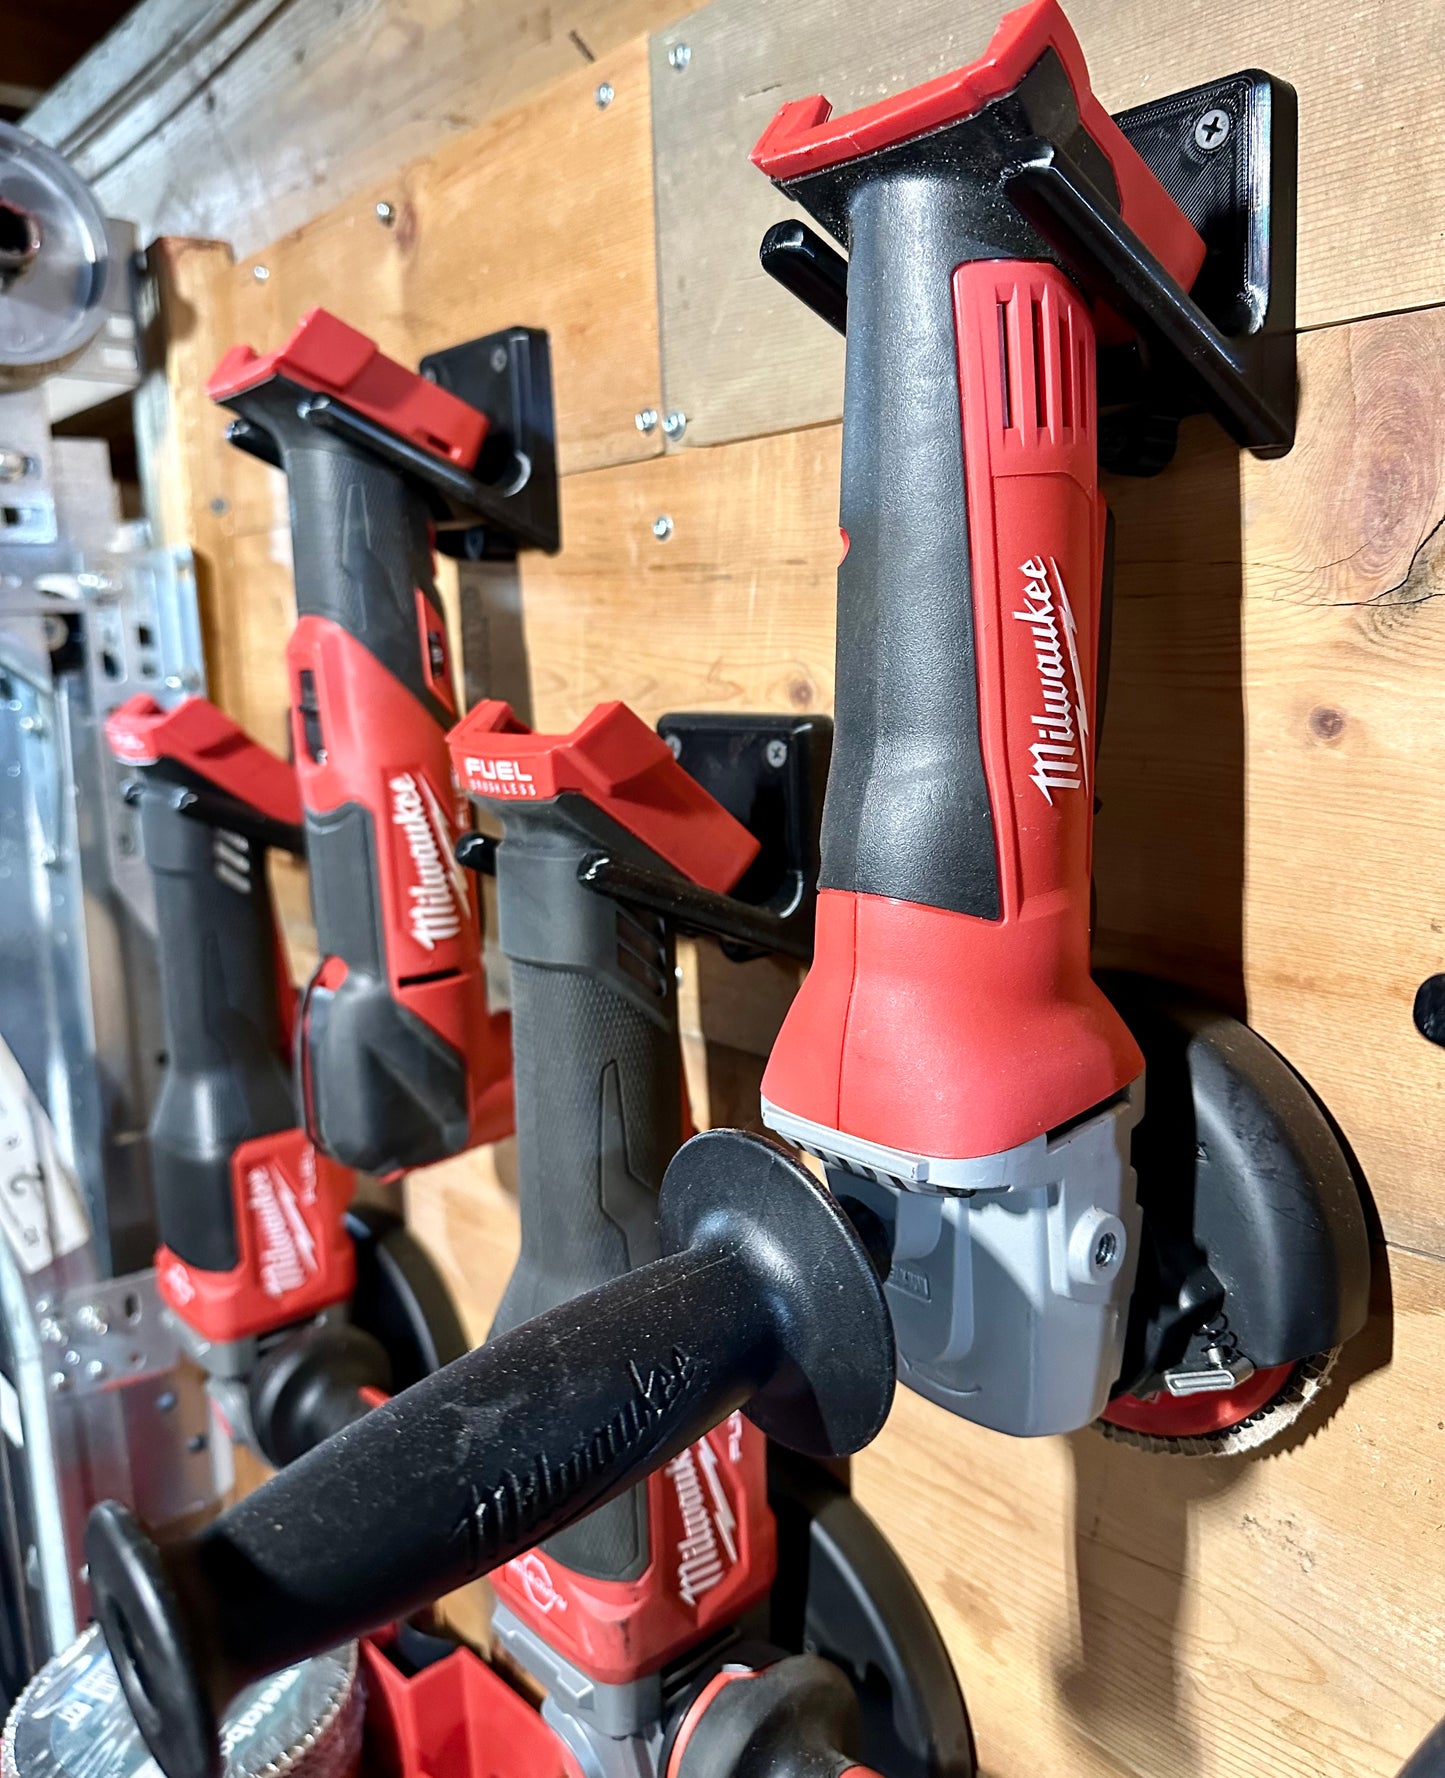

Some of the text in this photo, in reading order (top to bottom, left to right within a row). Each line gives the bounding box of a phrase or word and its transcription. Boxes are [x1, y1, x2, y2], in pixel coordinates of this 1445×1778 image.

[464, 756, 533, 782] FUEL
[1013, 555, 1082, 807] Milwaukee
[389, 772, 461, 951] Milwaukee
[452, 1343, 699, 1541] Milwaukee
[664, 1448, 726, 1607] Milwauk
